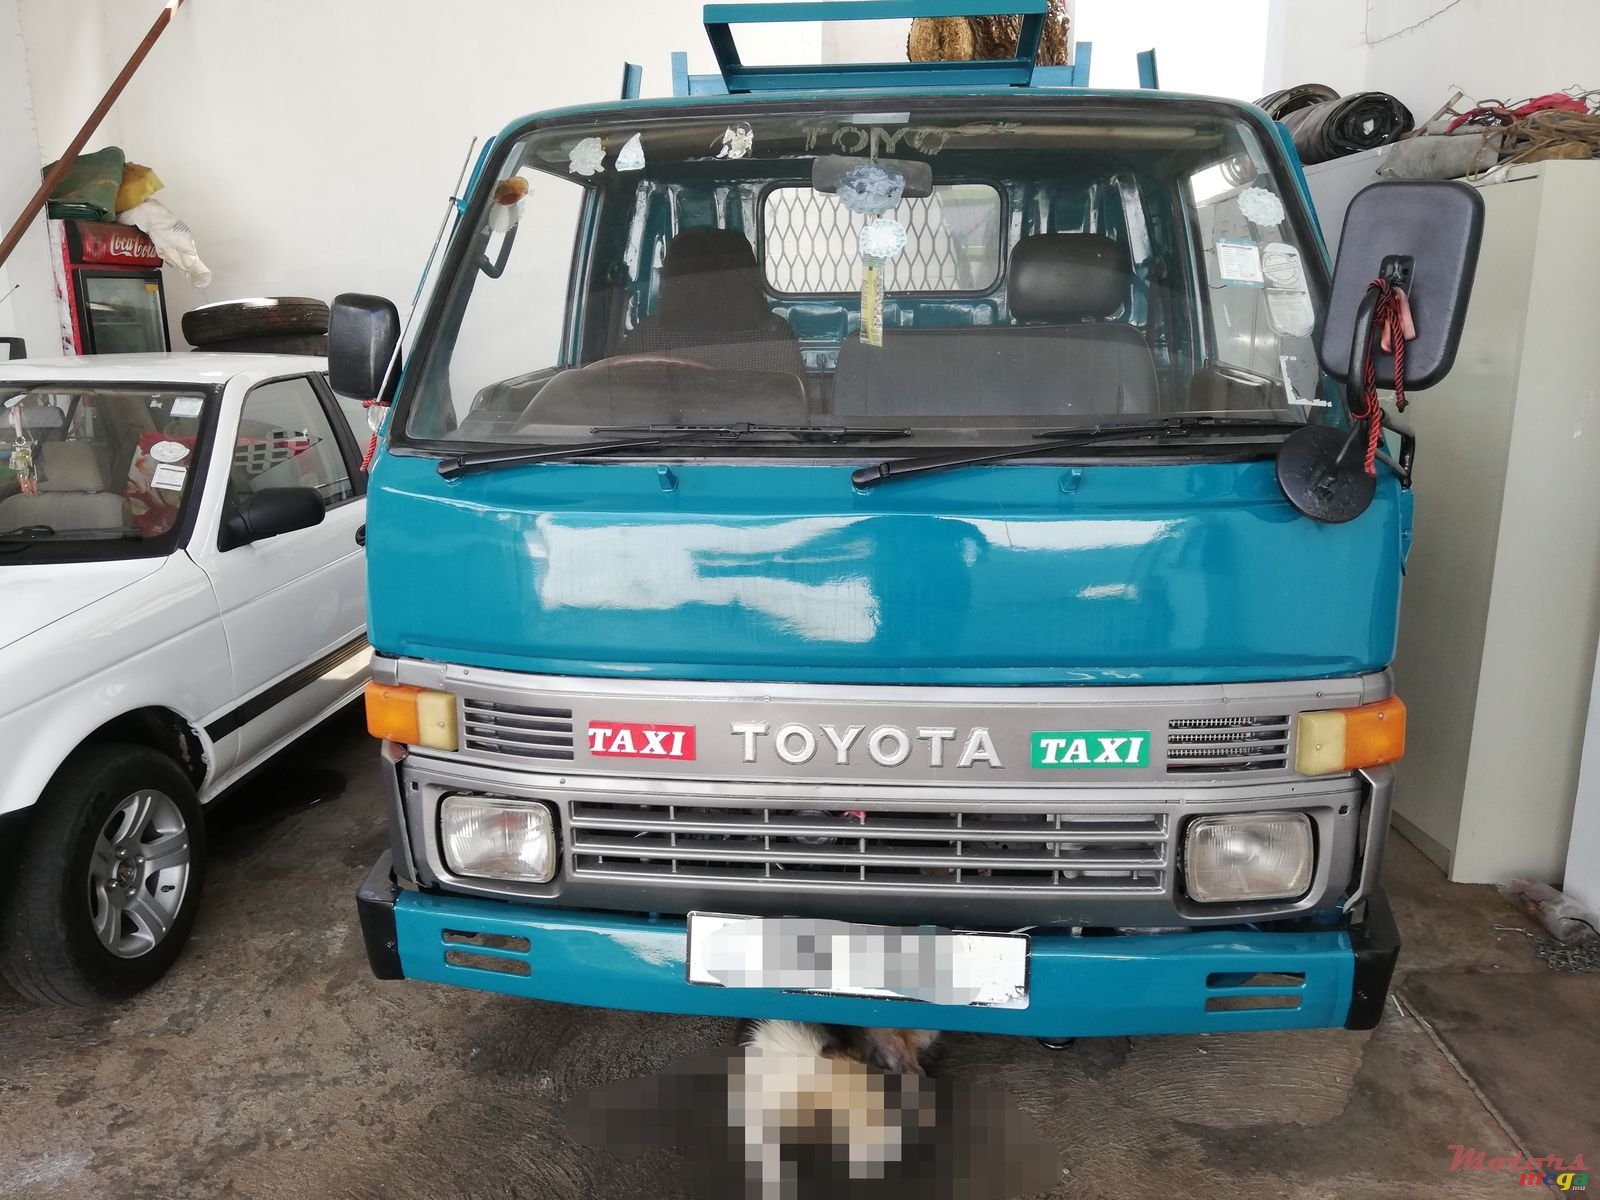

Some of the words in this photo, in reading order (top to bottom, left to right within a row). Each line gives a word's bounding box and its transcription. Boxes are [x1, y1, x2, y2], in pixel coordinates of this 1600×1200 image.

[588, 727, 686, 757] TAXI
[730, 721, 1004, 768] TOYOTA
[1039, 738, 1144, 764] TAXI
